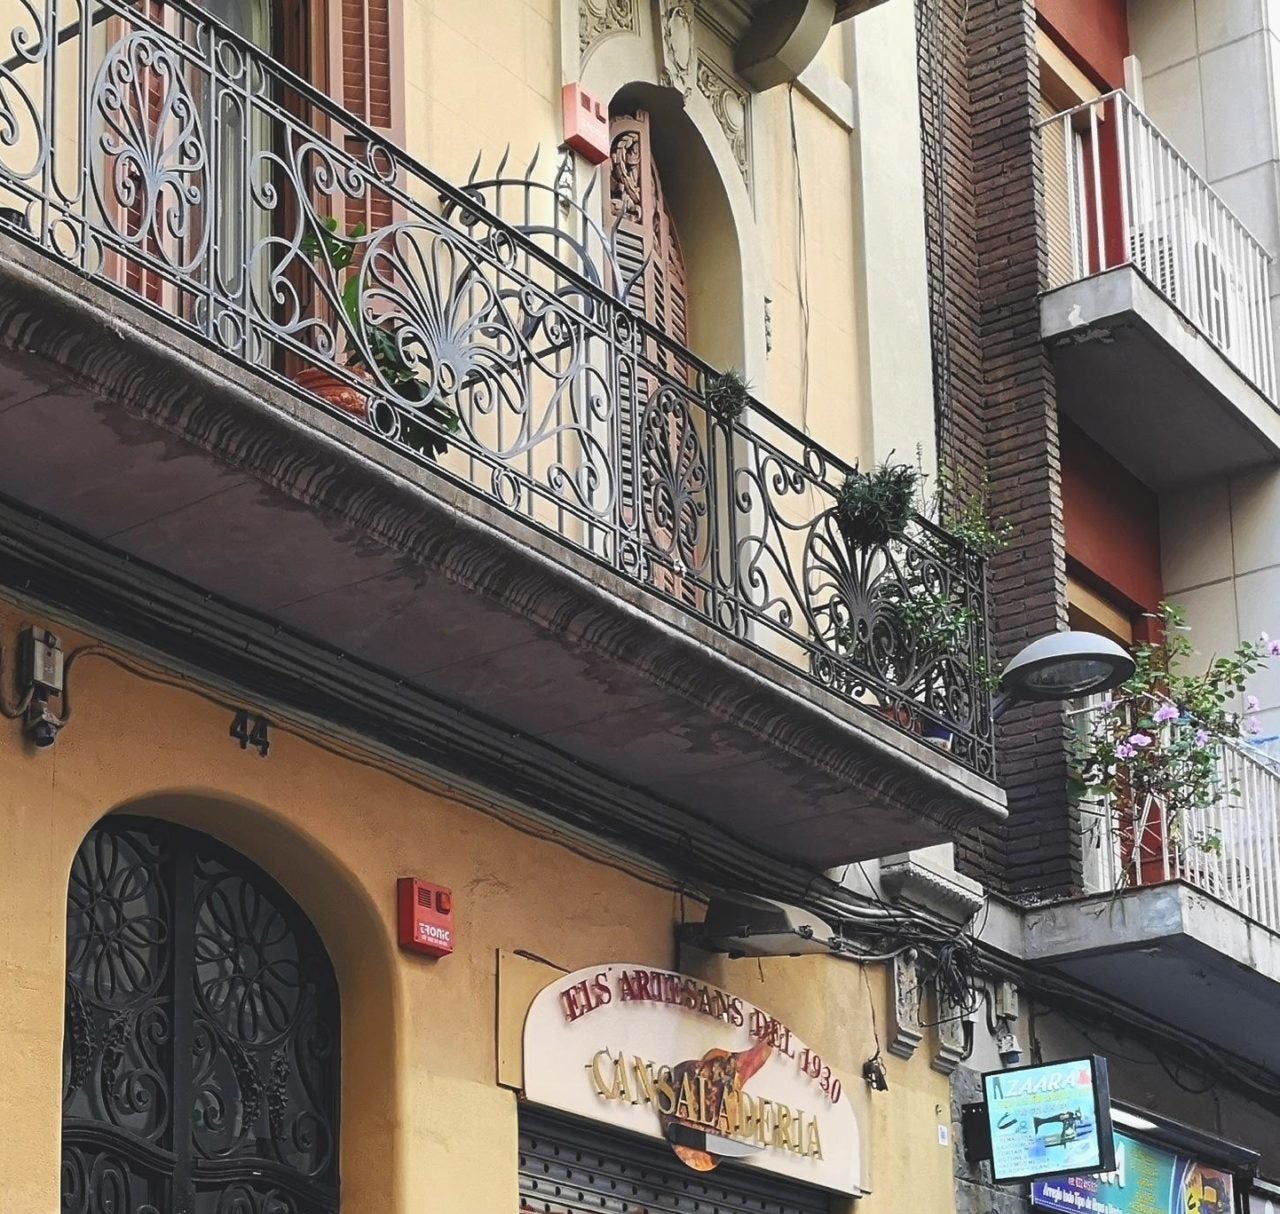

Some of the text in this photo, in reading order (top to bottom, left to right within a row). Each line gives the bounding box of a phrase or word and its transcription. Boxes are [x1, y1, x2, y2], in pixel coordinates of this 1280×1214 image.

[230, 709, 270, 757] 44
[560, 970, 841, 1104] ELS ARTESANS DEL 1930
[587, 1046, 824, 1161] CANSALADERIA
[1004, 1070, 1077, 1098] ZAARA
